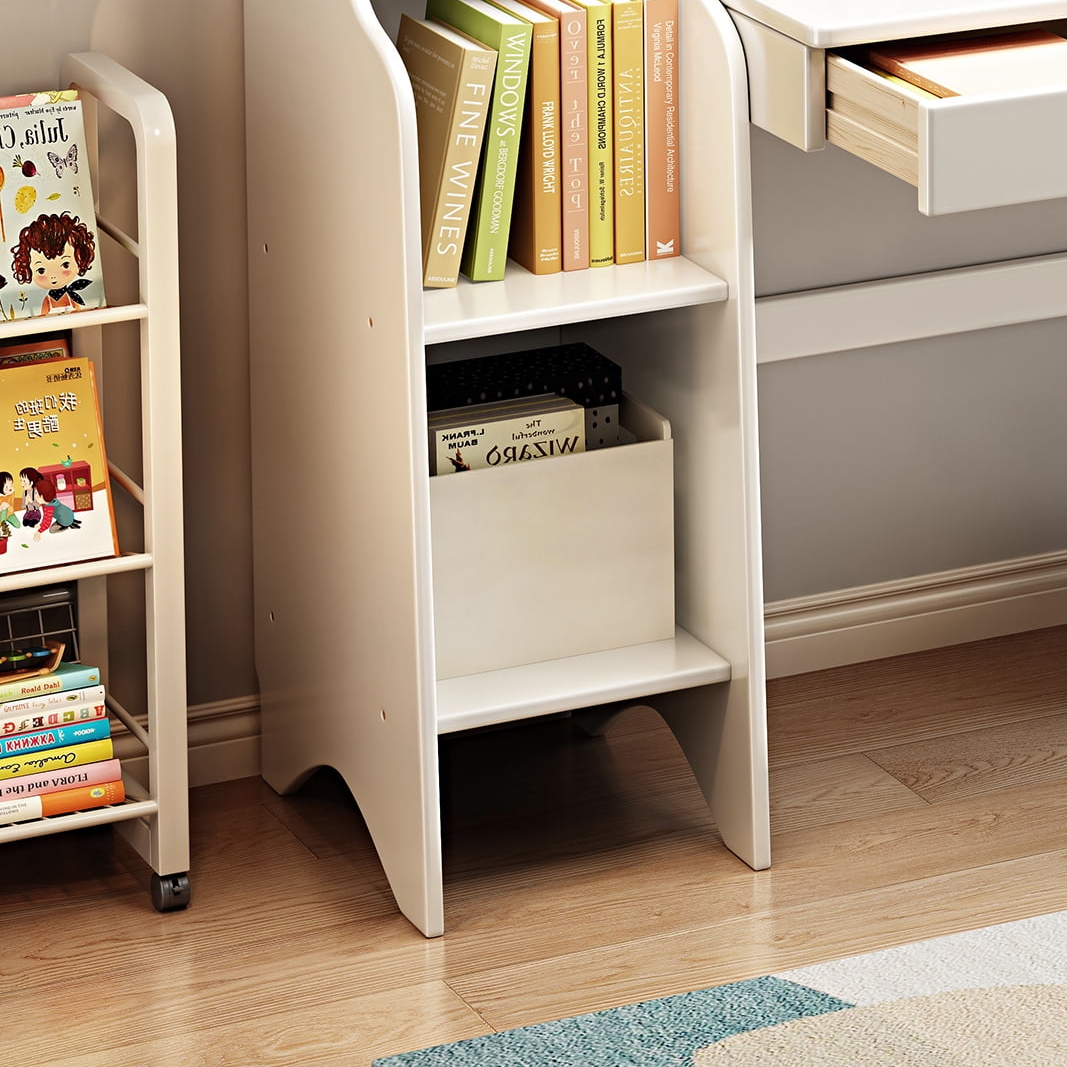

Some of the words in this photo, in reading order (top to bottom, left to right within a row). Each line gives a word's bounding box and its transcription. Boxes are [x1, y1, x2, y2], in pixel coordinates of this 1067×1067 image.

[652, 22, 662, 51] Virginia
[665, 20, 674, 42] Detail
[653, 52, 662, 82] McLeod
[664, 52, 675, 105] Contemporary
[496, 32, 526, 137] WINDOWS
[455, 82, 486, 147] FINE
[542, 101, 555, 129] FRANK
[666, 106, 675, 147] Residential
[542, 130, 555, 158] LLOYD
[493, 147, 507, 190] BERGDORF
[542, 160, 555, 194] WRIGHT
[666, 148, 675, 193] Architecture
[436, 161, 473, 256] WINES
[488, 190, 503, 234] GOODMAN
[21, 684, 41, 695] Roald
[43, 681, 60, 691] Dahl
[32, 716, 44, 728] E
[48, 713, 59, 725] D
[63, 711, 74, 722] C
[80, 707, 89, 718] B
[94, 705, 104, 716] A
[2, 722, 16, 734] G
[6, 732, 55, 752] КНИЖКА
[24, 752, 76, 768] Amelia
[5, 784, 24, 796] the
[27, 779, 49, 792] and
[51, 772, 88, 787] FLORA
